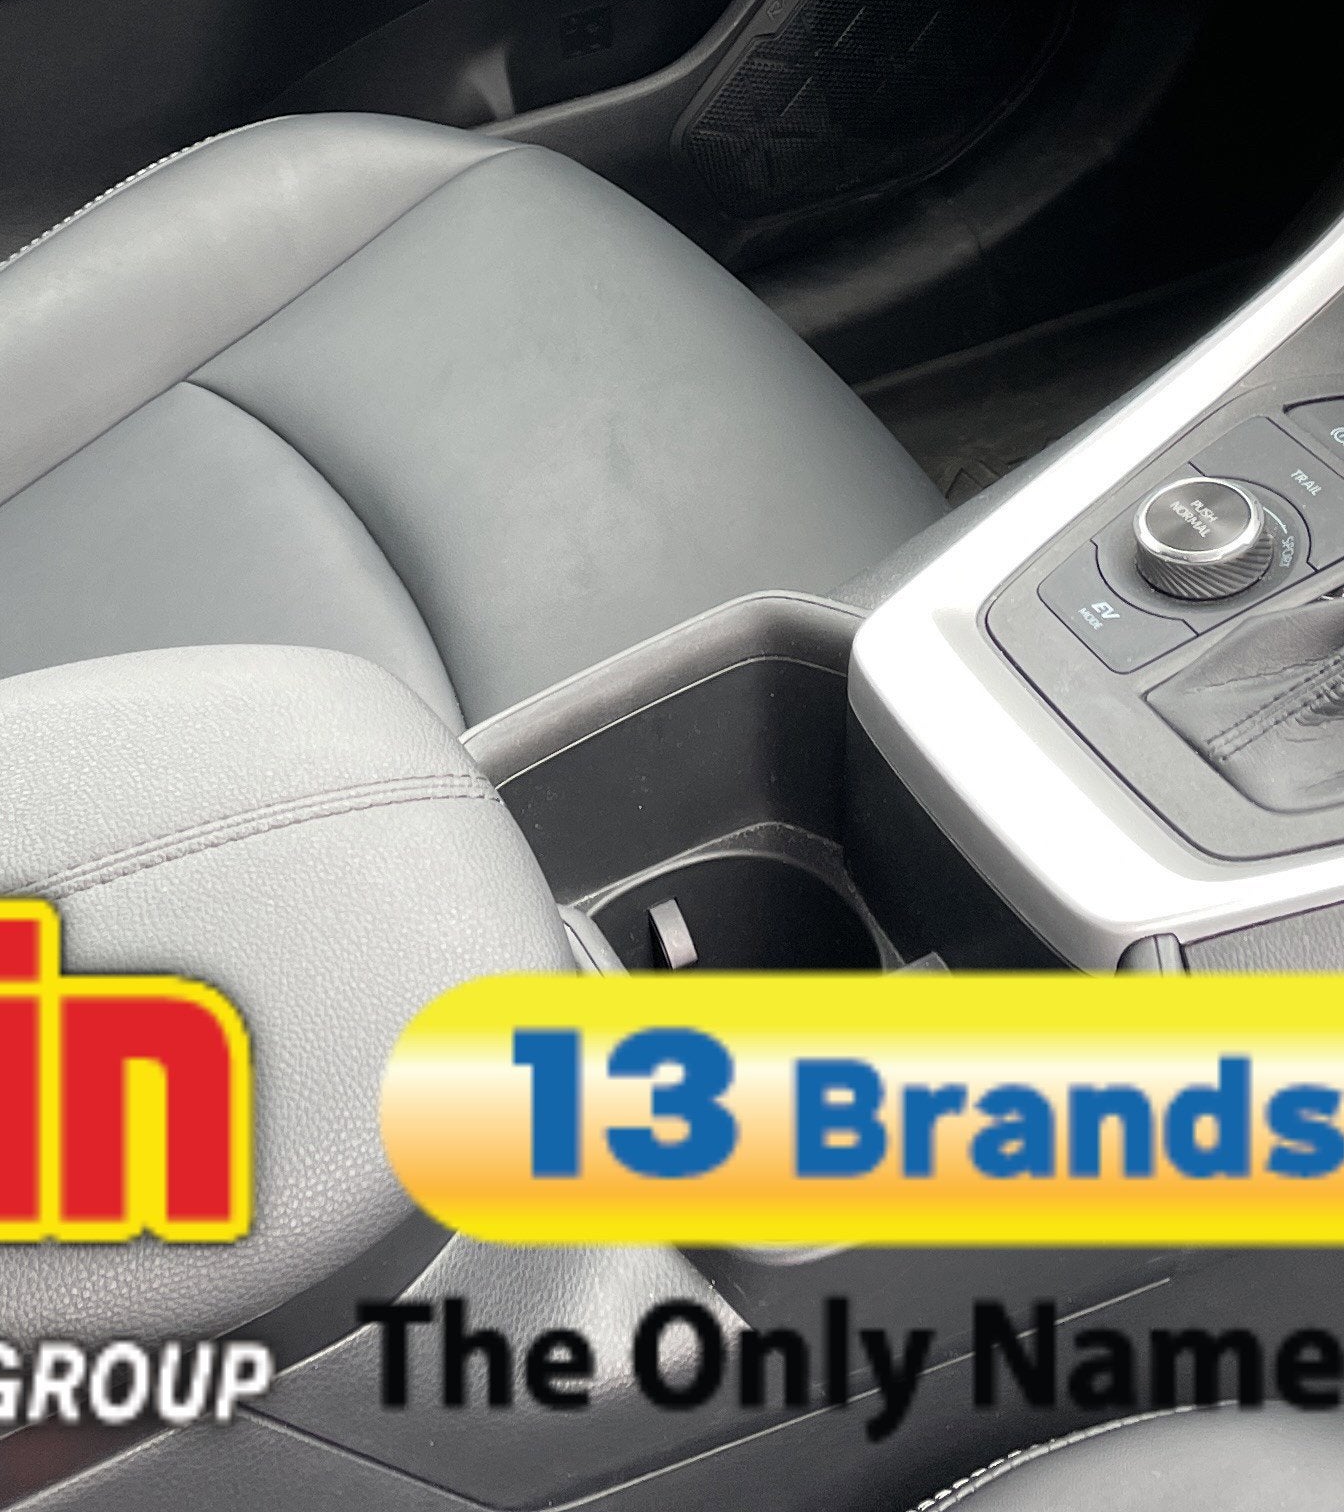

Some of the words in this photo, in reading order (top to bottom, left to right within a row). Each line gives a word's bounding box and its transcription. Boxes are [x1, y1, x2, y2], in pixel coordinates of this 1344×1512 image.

[1290, 469, 1323, 496] TRAIL
[1170, 501, 1211, 538] NORMAL
[1190, 500, 1218, 523] PUSH
[1279, 535, 1294, 567] SPORT
[1078, 607, 1102, 630] MODE
[1091, 601, 1120, 620] EV
